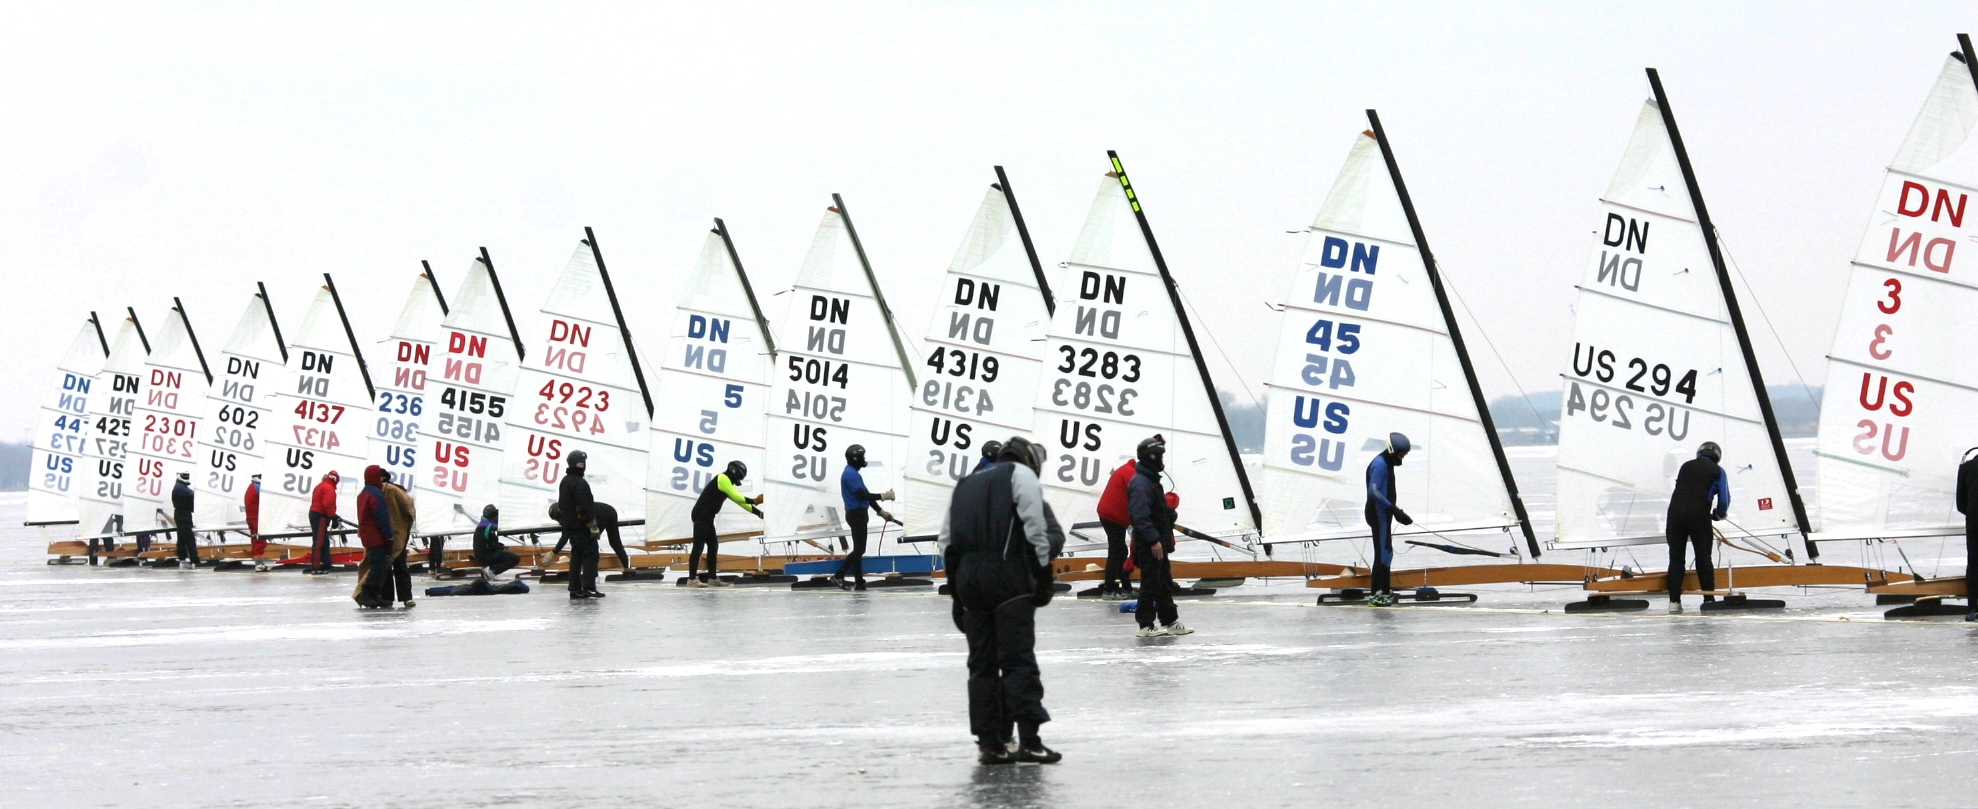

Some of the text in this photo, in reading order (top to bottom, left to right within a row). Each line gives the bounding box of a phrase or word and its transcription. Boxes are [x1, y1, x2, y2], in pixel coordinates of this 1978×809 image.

[1897, 180, 1968, 228] DN
[1603, 212, 1649, 254] DN
[1320, 236, 1380, 275] DN
[954, 278, 1000, 311] DN
[1080, 271, 1126, 305] DN
[1877, 278, 1902, 314] 3
[810, 295, 850, 325] DN
[550, 319, 591, 347] DN
[688, 314, 730, 343] DN
[1306, 319, 1361, 355] 45
[397, 341, 430, 365] DN
[448, 331, 487, 358] DN
[227, 357, 259, 379] DN
[301, 351, 333, 374] DN
[789, 355, 848, 389] 5014
[927, 346, 999, 383] 4319
[1057, 345, 1141, 383] 3283
[1573, 342, 1697, 404] US 294
[63, 373, 91, 394] DN
[113, 374, 140, 394] DN
[151, 369, 181, 389] DN
[379, 392, 423, 416] 236
[441, 387, 506, 418] 4155
[539, 379, 609, 412] 4923
[724, 384, 744, 408] 5
[1860, 372, 1914, 417] US
[54, 415, 89, 433] 44
[219, 405, 258, 429] 602
[294, 400, 345, 424] 4137
[1293, 396, 1350, 434] US
[96, 417, 131, 436] 425
[144, 414, 196, 438] 2301
[794, 423, 827, 452] US
[931, 417, 972, 450] US
[1060, 419, 1102, 451] US
[211, 450, 236, 471] US
[286, 448, 314, 469] US
[387, 445, 416, 468] US
[435, 441, 470, 467] US
[528, 434, 562, 460] US
[674, 438, 715, 467] US
[47, 454, 73, 473] US
[99, 459, 124, 479] US
[139, 458, 163, 478] US
